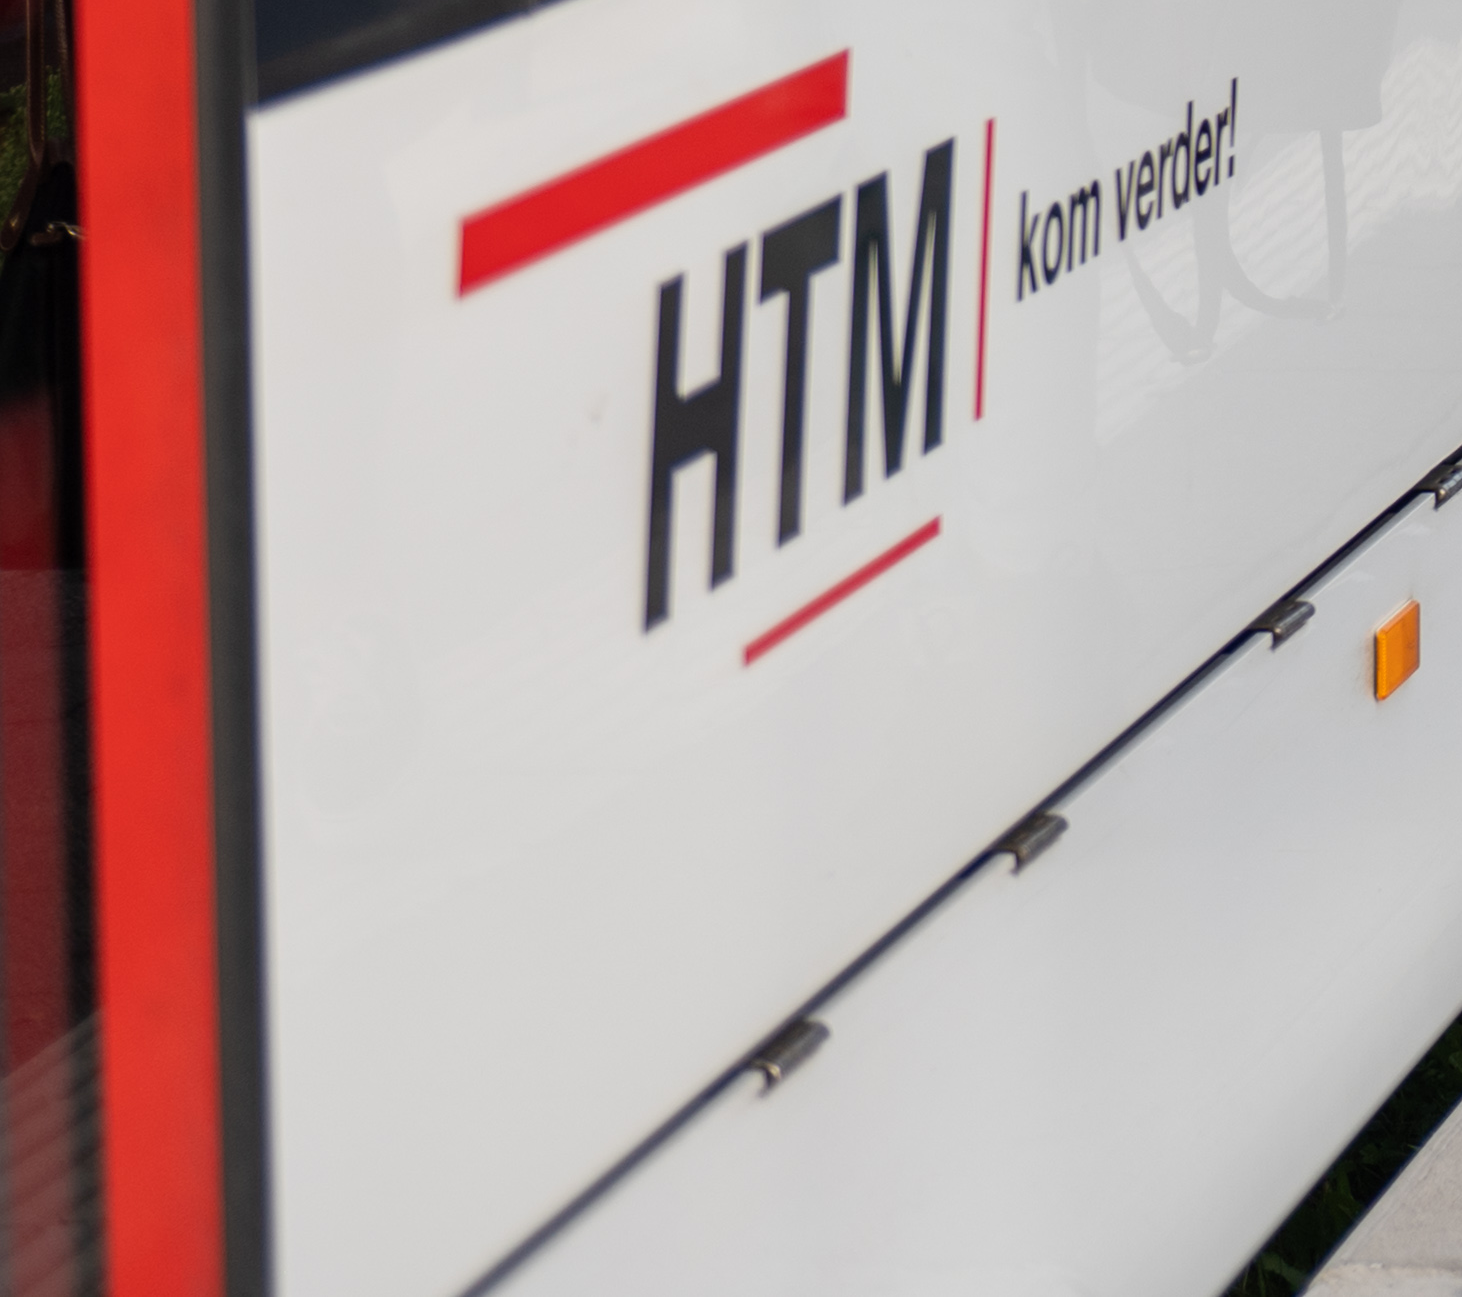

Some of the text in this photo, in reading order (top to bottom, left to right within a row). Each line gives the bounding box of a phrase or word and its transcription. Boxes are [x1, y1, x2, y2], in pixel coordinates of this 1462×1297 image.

[1016, 77, 1239, 301] kom verder!
[642, 137, 957, 635] HTM
